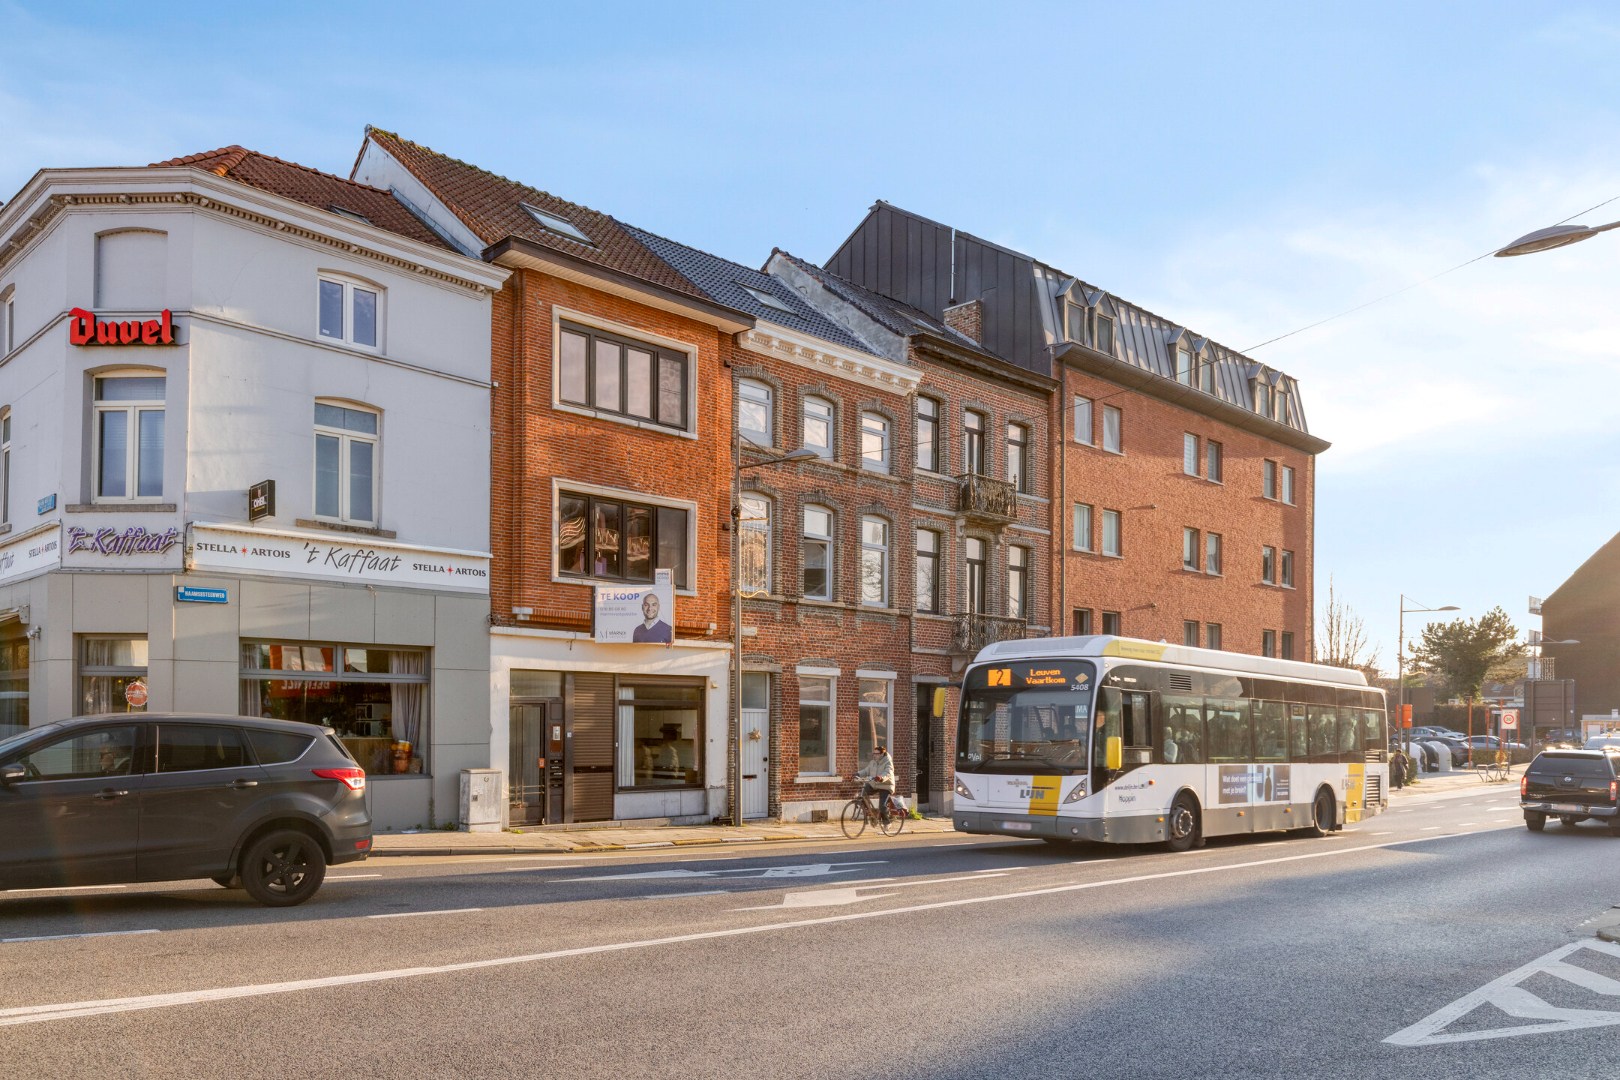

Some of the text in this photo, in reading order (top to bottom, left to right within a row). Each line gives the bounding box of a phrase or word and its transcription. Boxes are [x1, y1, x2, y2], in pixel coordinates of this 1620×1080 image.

[68, 307, 174, 346] Duvel
[91, 527, 177, 556] Kaffaat
[196, 542, 291, 558] STELLA ARTOIS
[303, 542, 402, 574] 't Kaffaat
[412, 563, 487, 577] STELLA ARTOIS
[1030, 669, 1061, 677] Leuven
[1025, 677, 1066, 685] Vaartkom
[1071, 684, 1089, 692] 5408
